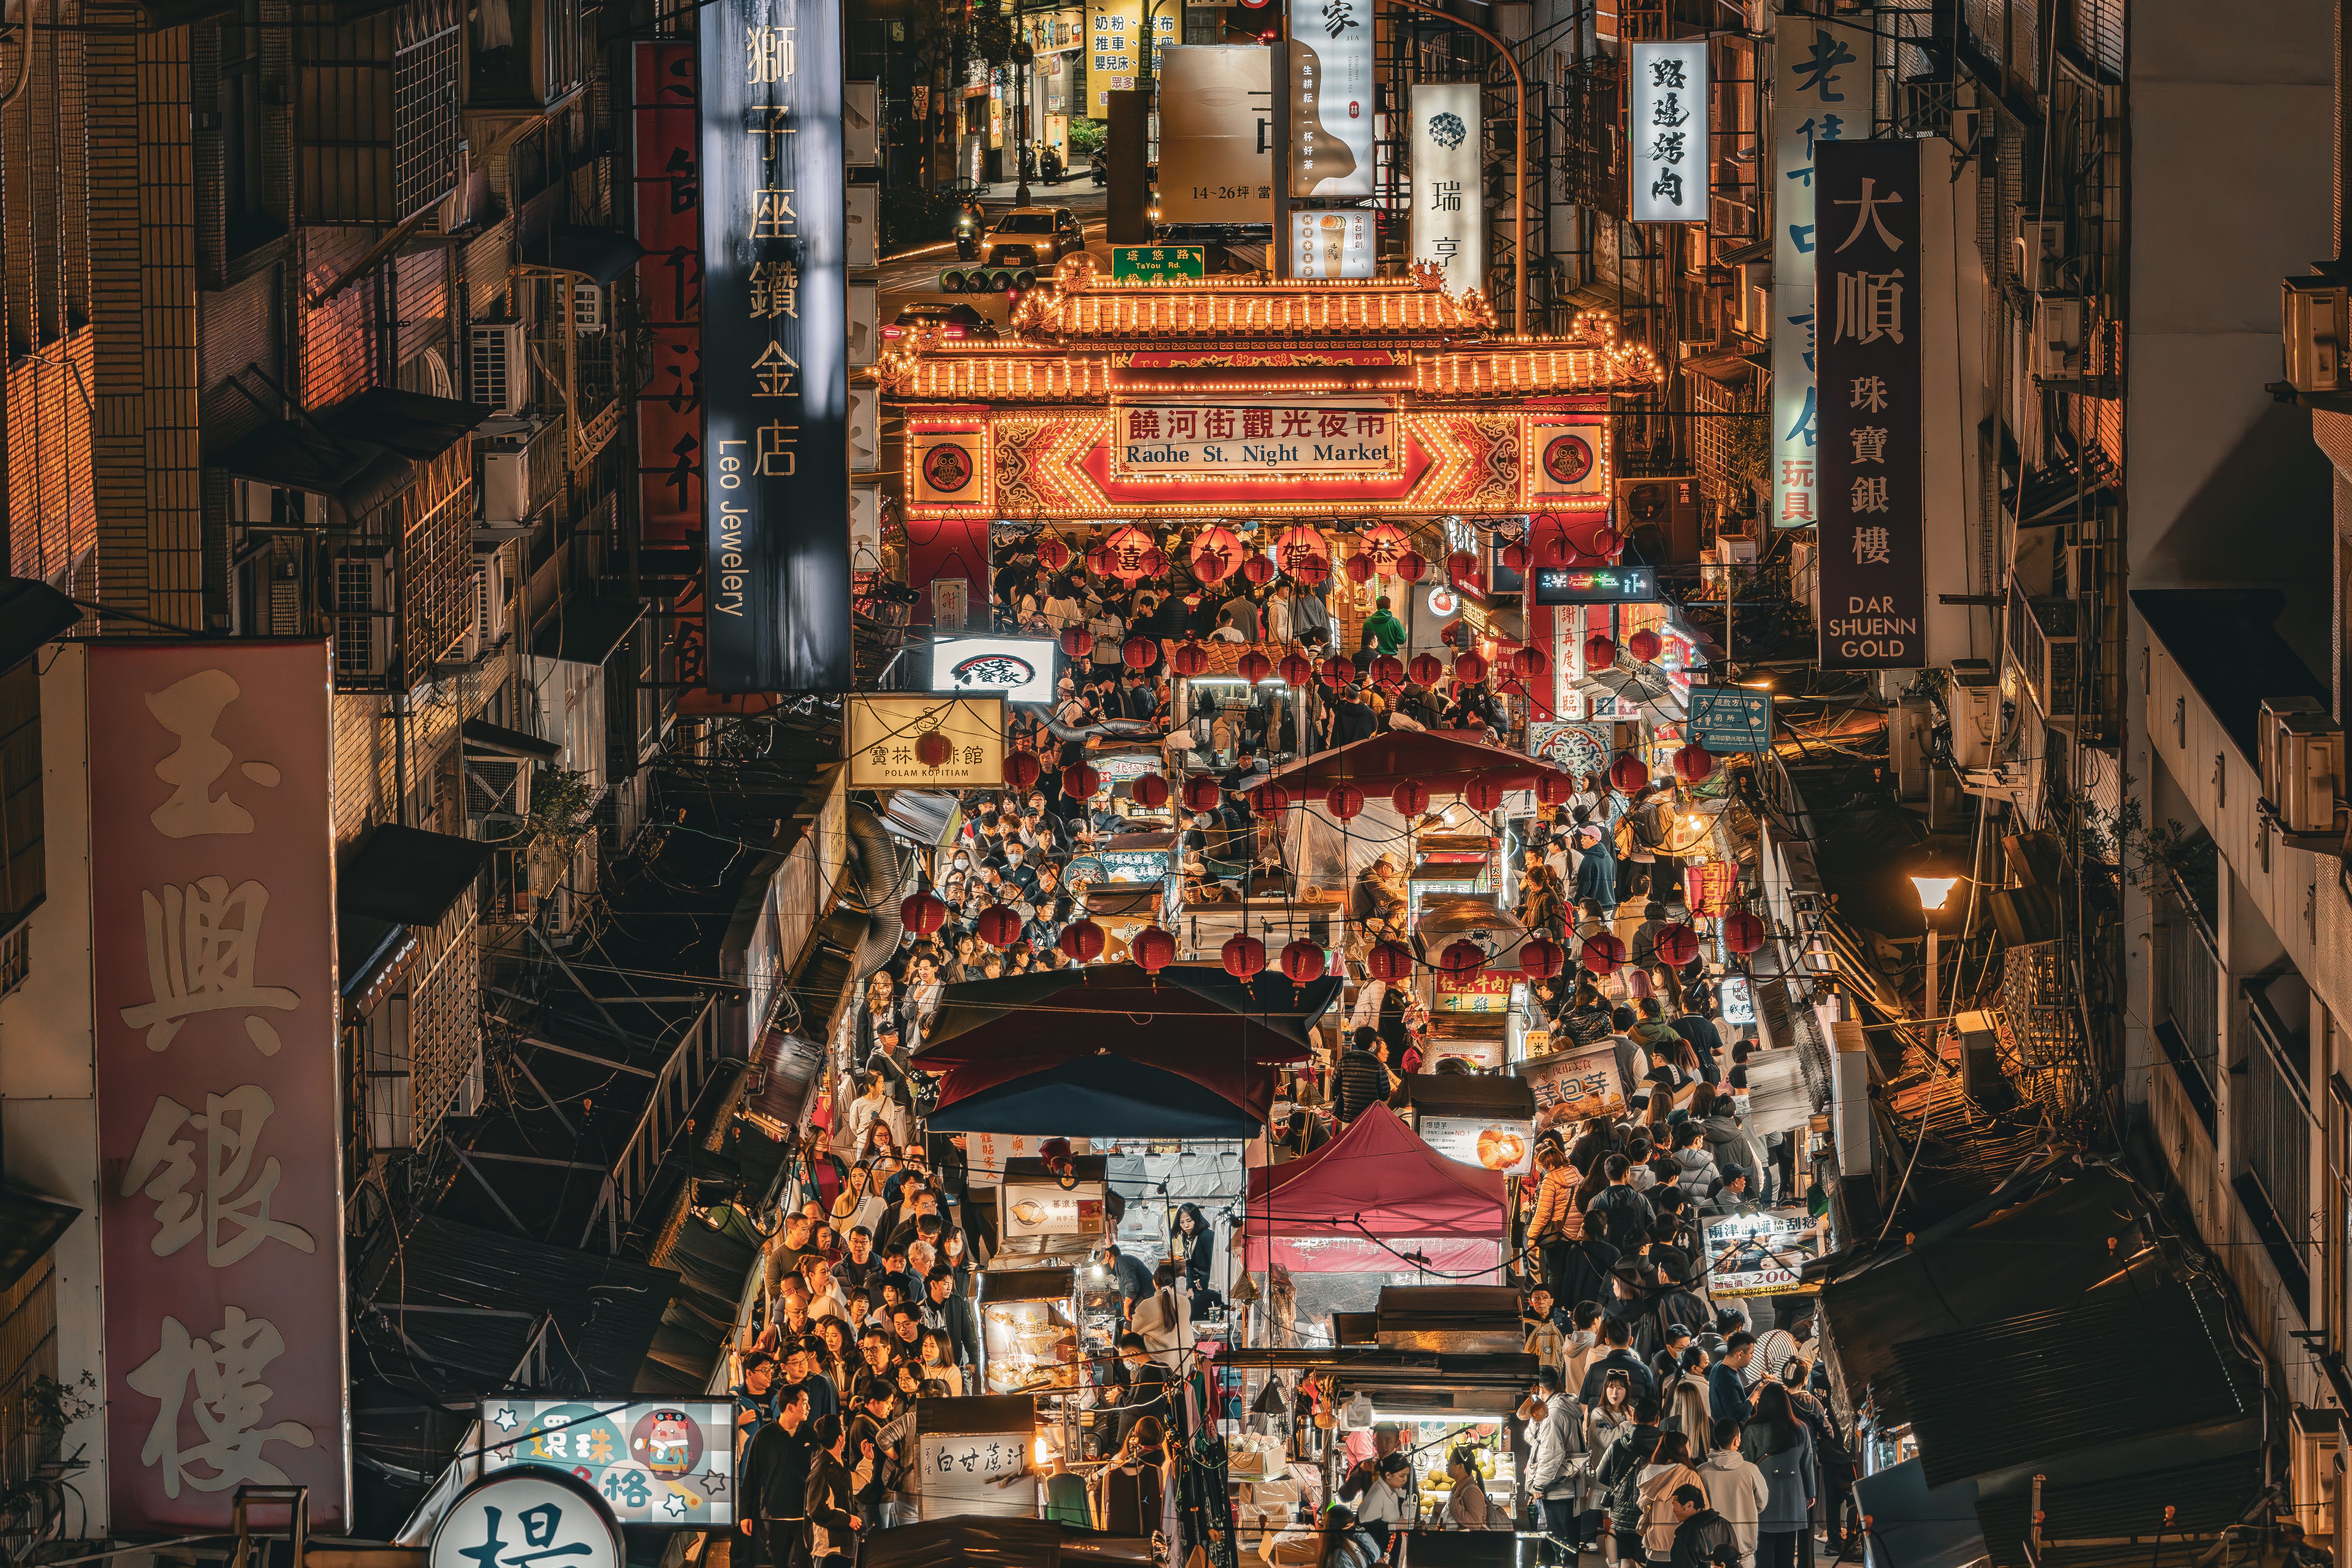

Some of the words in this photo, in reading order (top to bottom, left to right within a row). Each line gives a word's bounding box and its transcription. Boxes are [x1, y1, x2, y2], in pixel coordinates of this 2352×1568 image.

[747, 25, 799, 476] 獅子座鑽金店
[1127, 249, 1189, 261] 塔悠路
[1128, 408, 1386, 440] 饒河街觀光夜市
[719, 439, 747, 490] Leo
[1126, 445, 1190, 463] Raohe
[1203, 445, 1229, 463] St.
[1243, 444, 1298, 466] Night
[1314, 442, 1391, 461] Market
[1850, 376, 1890, 564] 珠寶銀樓
[1782, 460, 1814, 521] 玩具
[715, 501, 749, 617] Jewelery
[1849, 596, 1895, 614] DAR
[1829, 618, 1916, 636] SHUENN
[1842, 640, 1904, 658] GOLD
[869, 746, 984, 766] 寶林館
[1534, 1071, 1610, 1107] 芋包芋
[1744, 1271, 1792, 1285] $200
[937, 1441, 1025, 1475] 白甘蔗汁
[571, 1465, 653, 1508] 格
